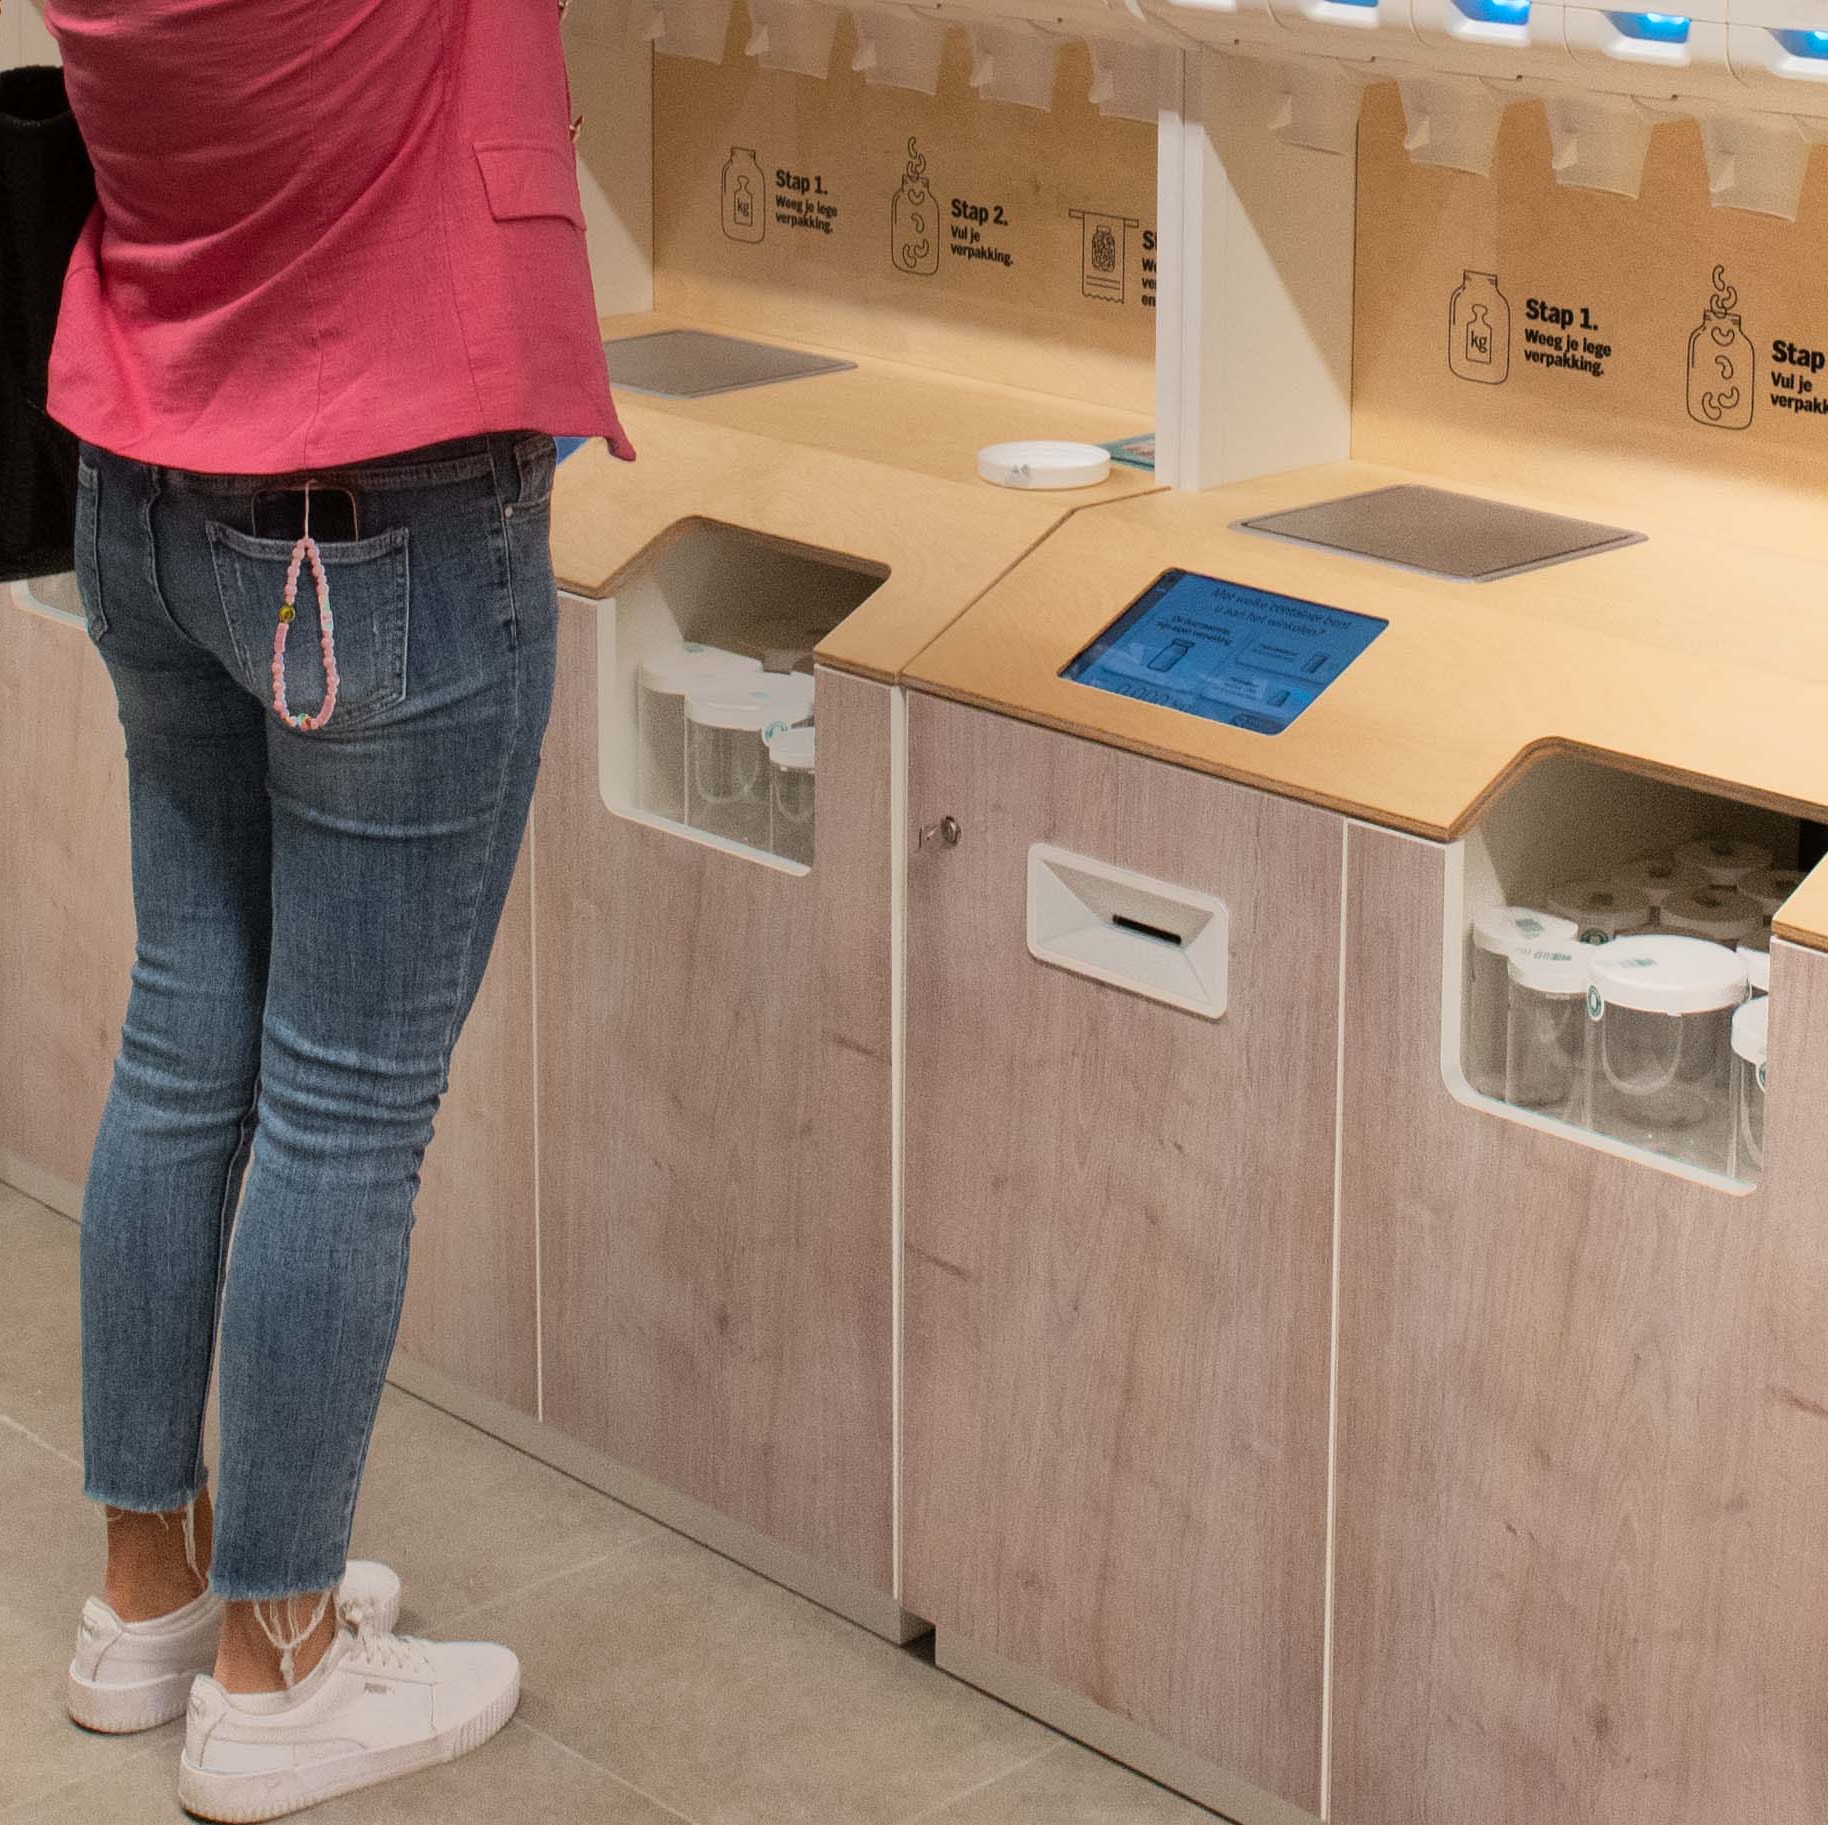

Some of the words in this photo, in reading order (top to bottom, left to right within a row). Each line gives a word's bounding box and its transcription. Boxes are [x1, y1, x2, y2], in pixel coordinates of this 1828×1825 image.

[776, 169, 810, 194] Stap
[814, 176, 828, 195] 1.
[776, 194, 802, 213] Weeg
[804, 200, 814, 216] je
[818, 201, 837, 219] lege
[951, 198, 989, 225] Stap
[994, 206, 1008, 226] 2.
[776, 212, 833, 234] verpakking.
[951, 224, 967, 240] Vul
[970, 228, 980, 243] je
[950, 243, 1014, 266] verpakking.
[1525, 298, 1573, 329] Stap
[1580, 308, 1598, 330] 1.
[1525, 328, 1562, 351] Weeg
[1566, 334, 1578, 352] je
[1583, 337, 1612, 358] lege
[1524, 349, 1604, 376] verpakking.
[1772, 340, 1825, 373] Stap
[1771, 371, 1794, 389] Vul
[1797, 376, 1812, 394] je
